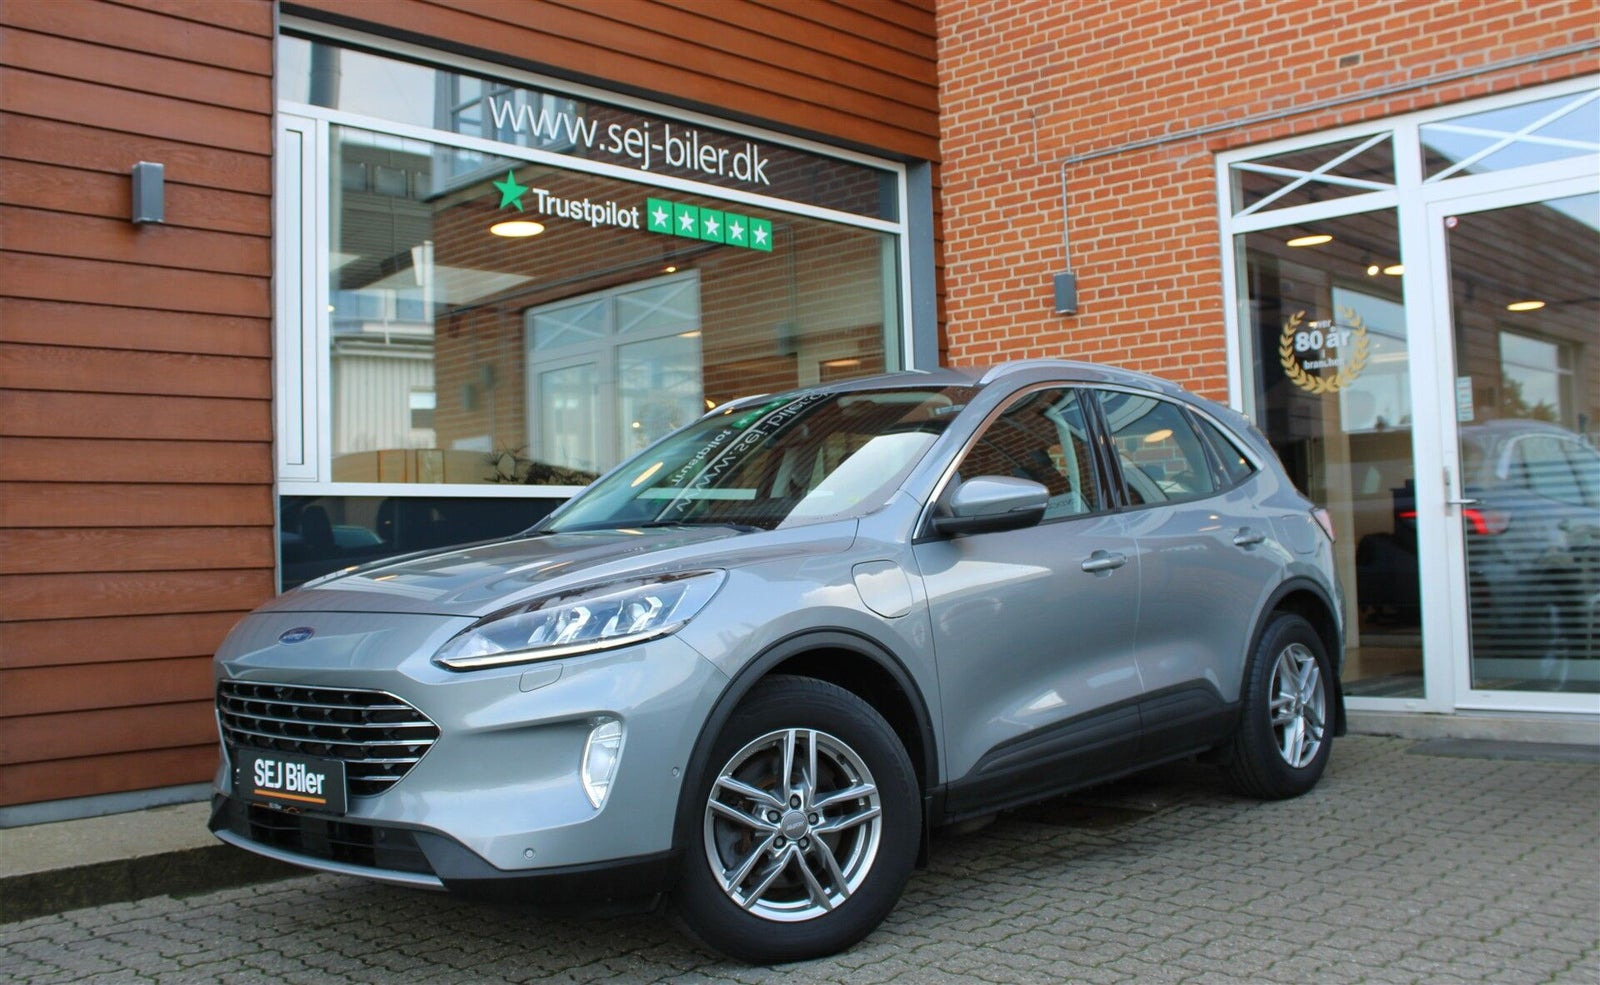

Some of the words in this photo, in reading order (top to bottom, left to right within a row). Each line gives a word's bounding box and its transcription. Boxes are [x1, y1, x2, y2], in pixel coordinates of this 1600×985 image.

[488, 96, 770, 185] www.sej-biler.dk
[532, 187, 640, 229] Trustpilot
[1295, 330, 1324, 352] 80
[1326, 326, 1352, 348] år
[254, 758, 283, 789] SEJ
[285, 762, 325, 795] Biler
